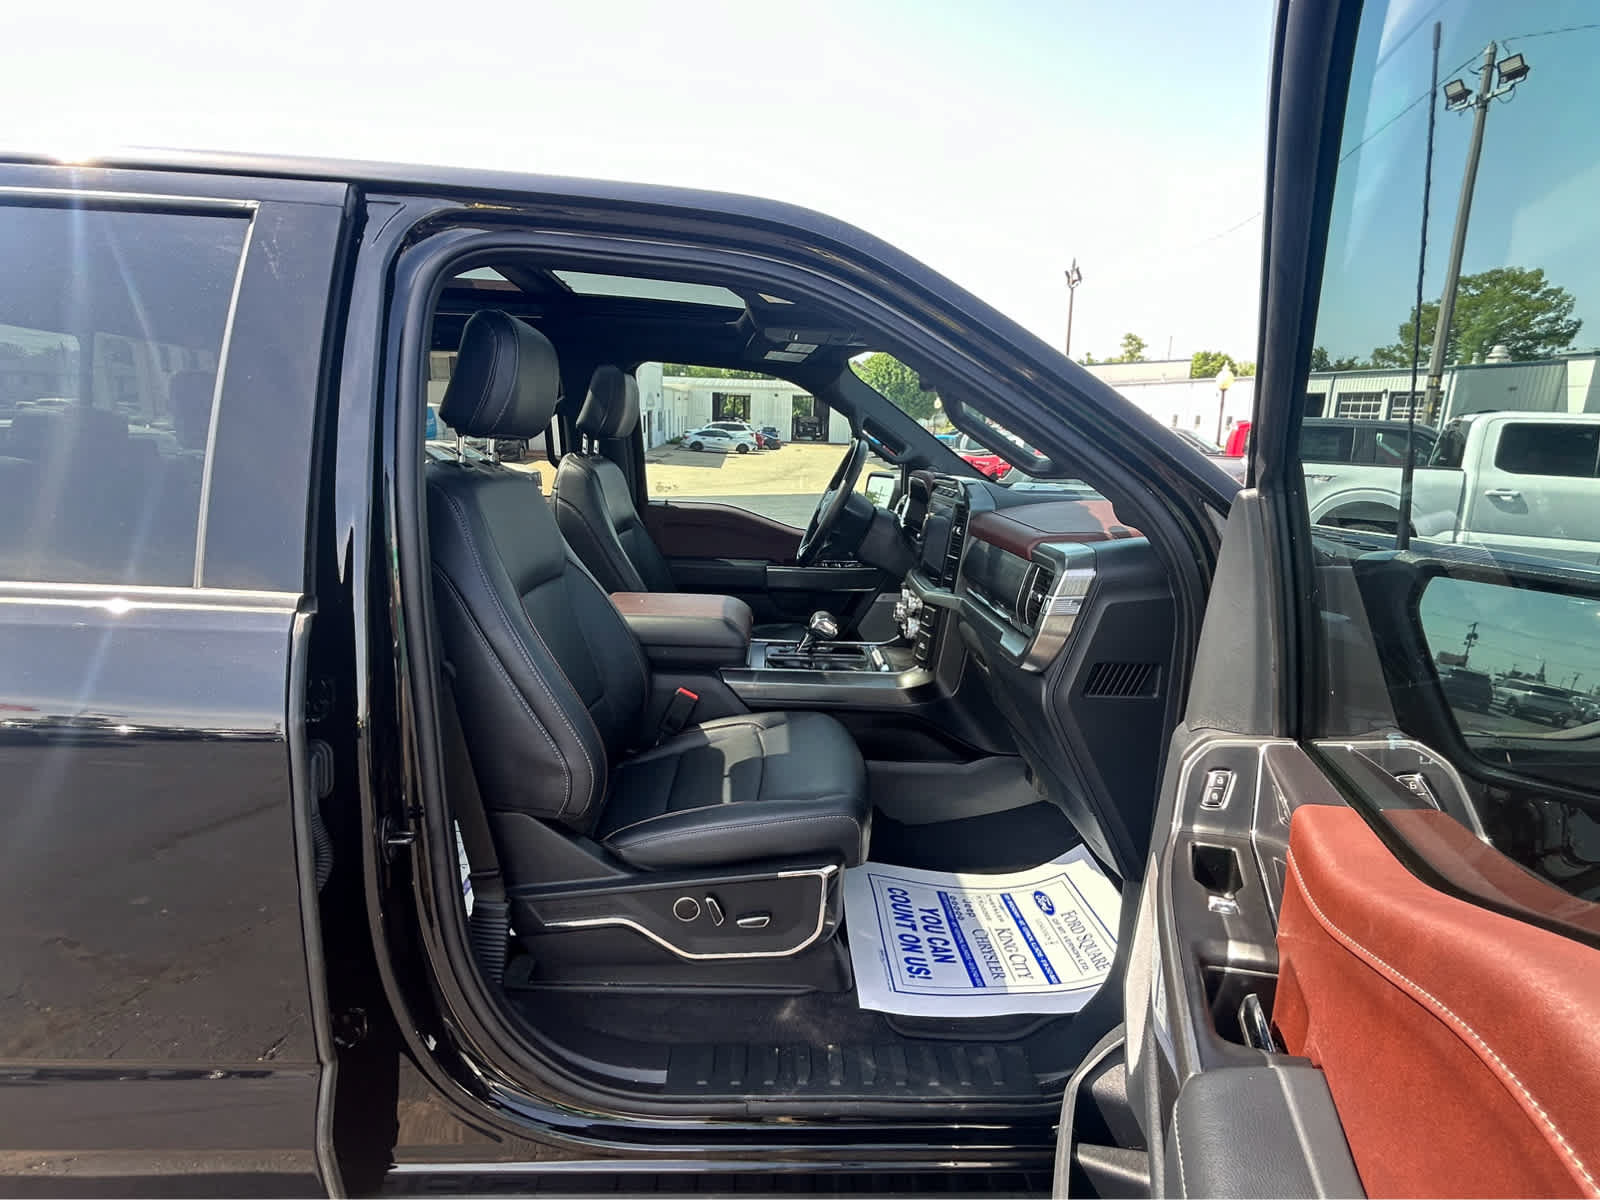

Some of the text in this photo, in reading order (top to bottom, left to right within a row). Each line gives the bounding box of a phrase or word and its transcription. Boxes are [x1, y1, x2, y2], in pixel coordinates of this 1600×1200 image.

[887, 887, 933, 980] COUNT ON US!
[918, 908, 957, 963] YOU CAN
[971, 928, 1006, 980] CHRYSLER
[995, 927, 1034, 980] KING CITY
[1060, 909, 1113, 972] FORD SQUARE
